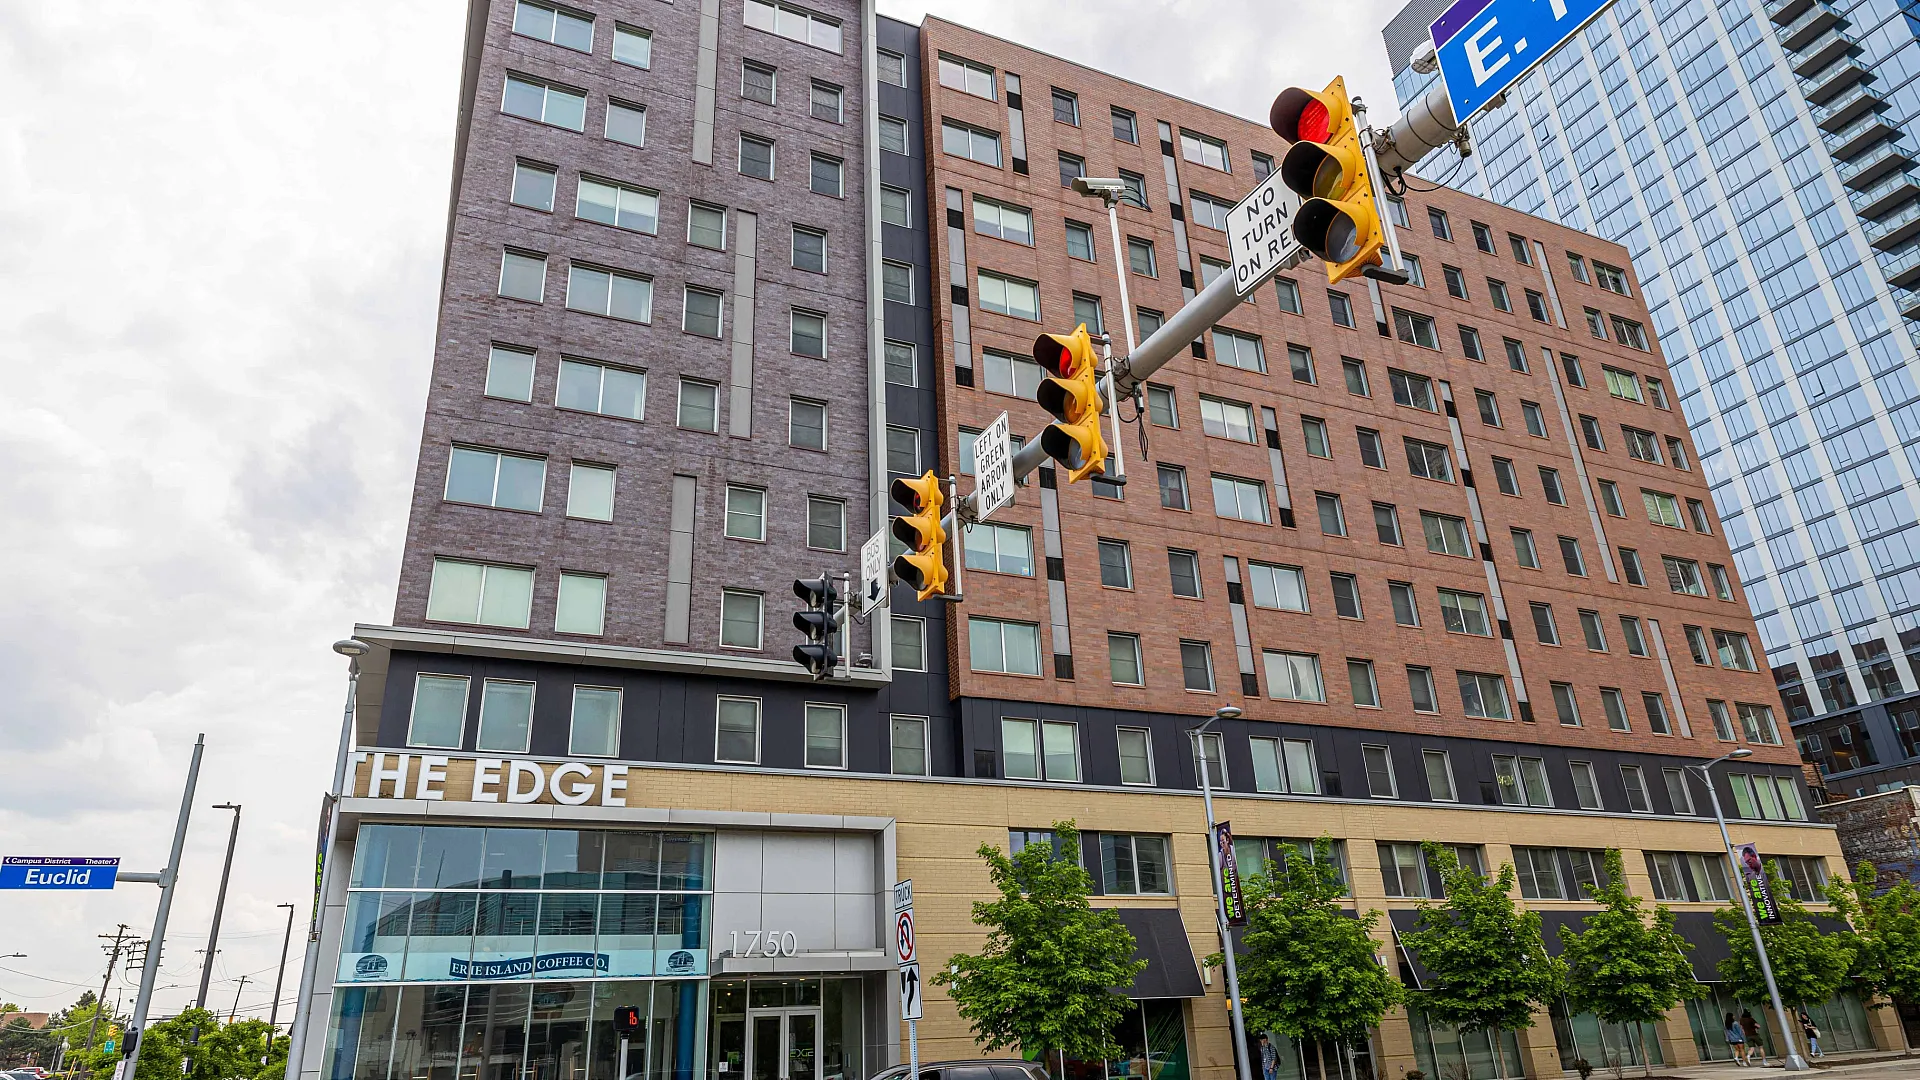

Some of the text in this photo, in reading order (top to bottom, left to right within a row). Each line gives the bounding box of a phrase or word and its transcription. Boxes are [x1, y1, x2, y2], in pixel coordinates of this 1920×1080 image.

[1463, 15, 1528, 88] E.
[1246, 187, 1275, 222] NO
[1242, 201, 1289, 251] TURN
[1238, 224, 1297, 282] ON RE
[975, 418, 1007, 459] LEFT ON
[980, 441, 1005, 474] GREEN
[981, 458, 1008, 494] ARROW
[985, 481, 1005, 510] ONLY
[865, 554, 882, 581] ONLY
[342, 752, 629, 806] THE EDGE
[11, 857, 42, 865] Campus
[25, 868, 92, 885] Euclid
[895, 884, 912, 904] TRUCK
[1223, 868, 1235, 919] we are
[1226, 853, 1242, 919] DETERMINED
[1750, 879, 1768, 919] we are
[1756, 874, 1775, 920] INNOVATIVE
[730, 930, 798, 958] 1750
[452, 956, 608, 976] ERIE ISLAND COFFEE CO.
